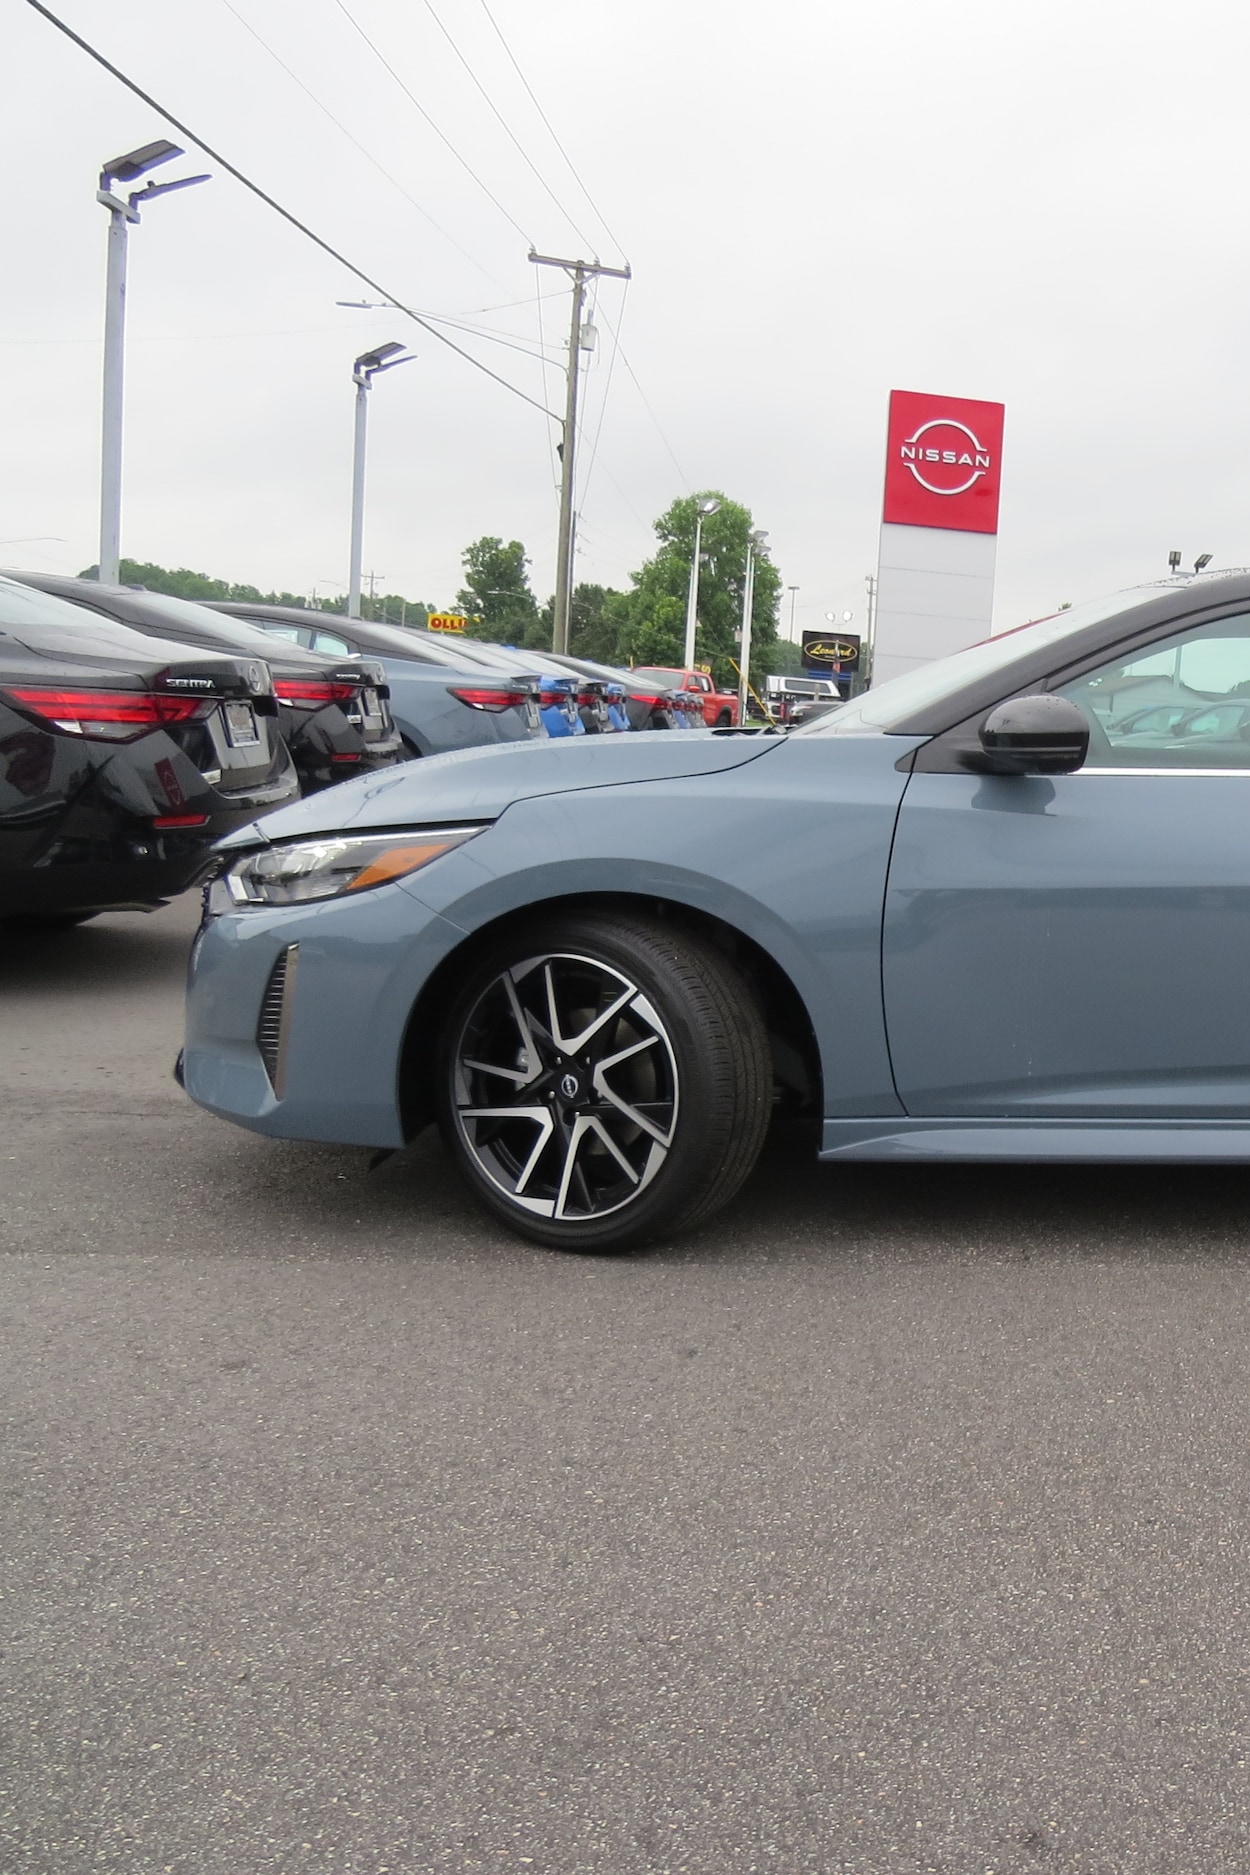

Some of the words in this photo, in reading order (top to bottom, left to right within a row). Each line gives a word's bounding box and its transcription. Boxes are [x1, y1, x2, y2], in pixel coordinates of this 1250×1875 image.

[900, 445, 991, 469] NISSAN
[810, 643, 853, 657] Leonrd
[165, 678, 217, 689] SENTRA
